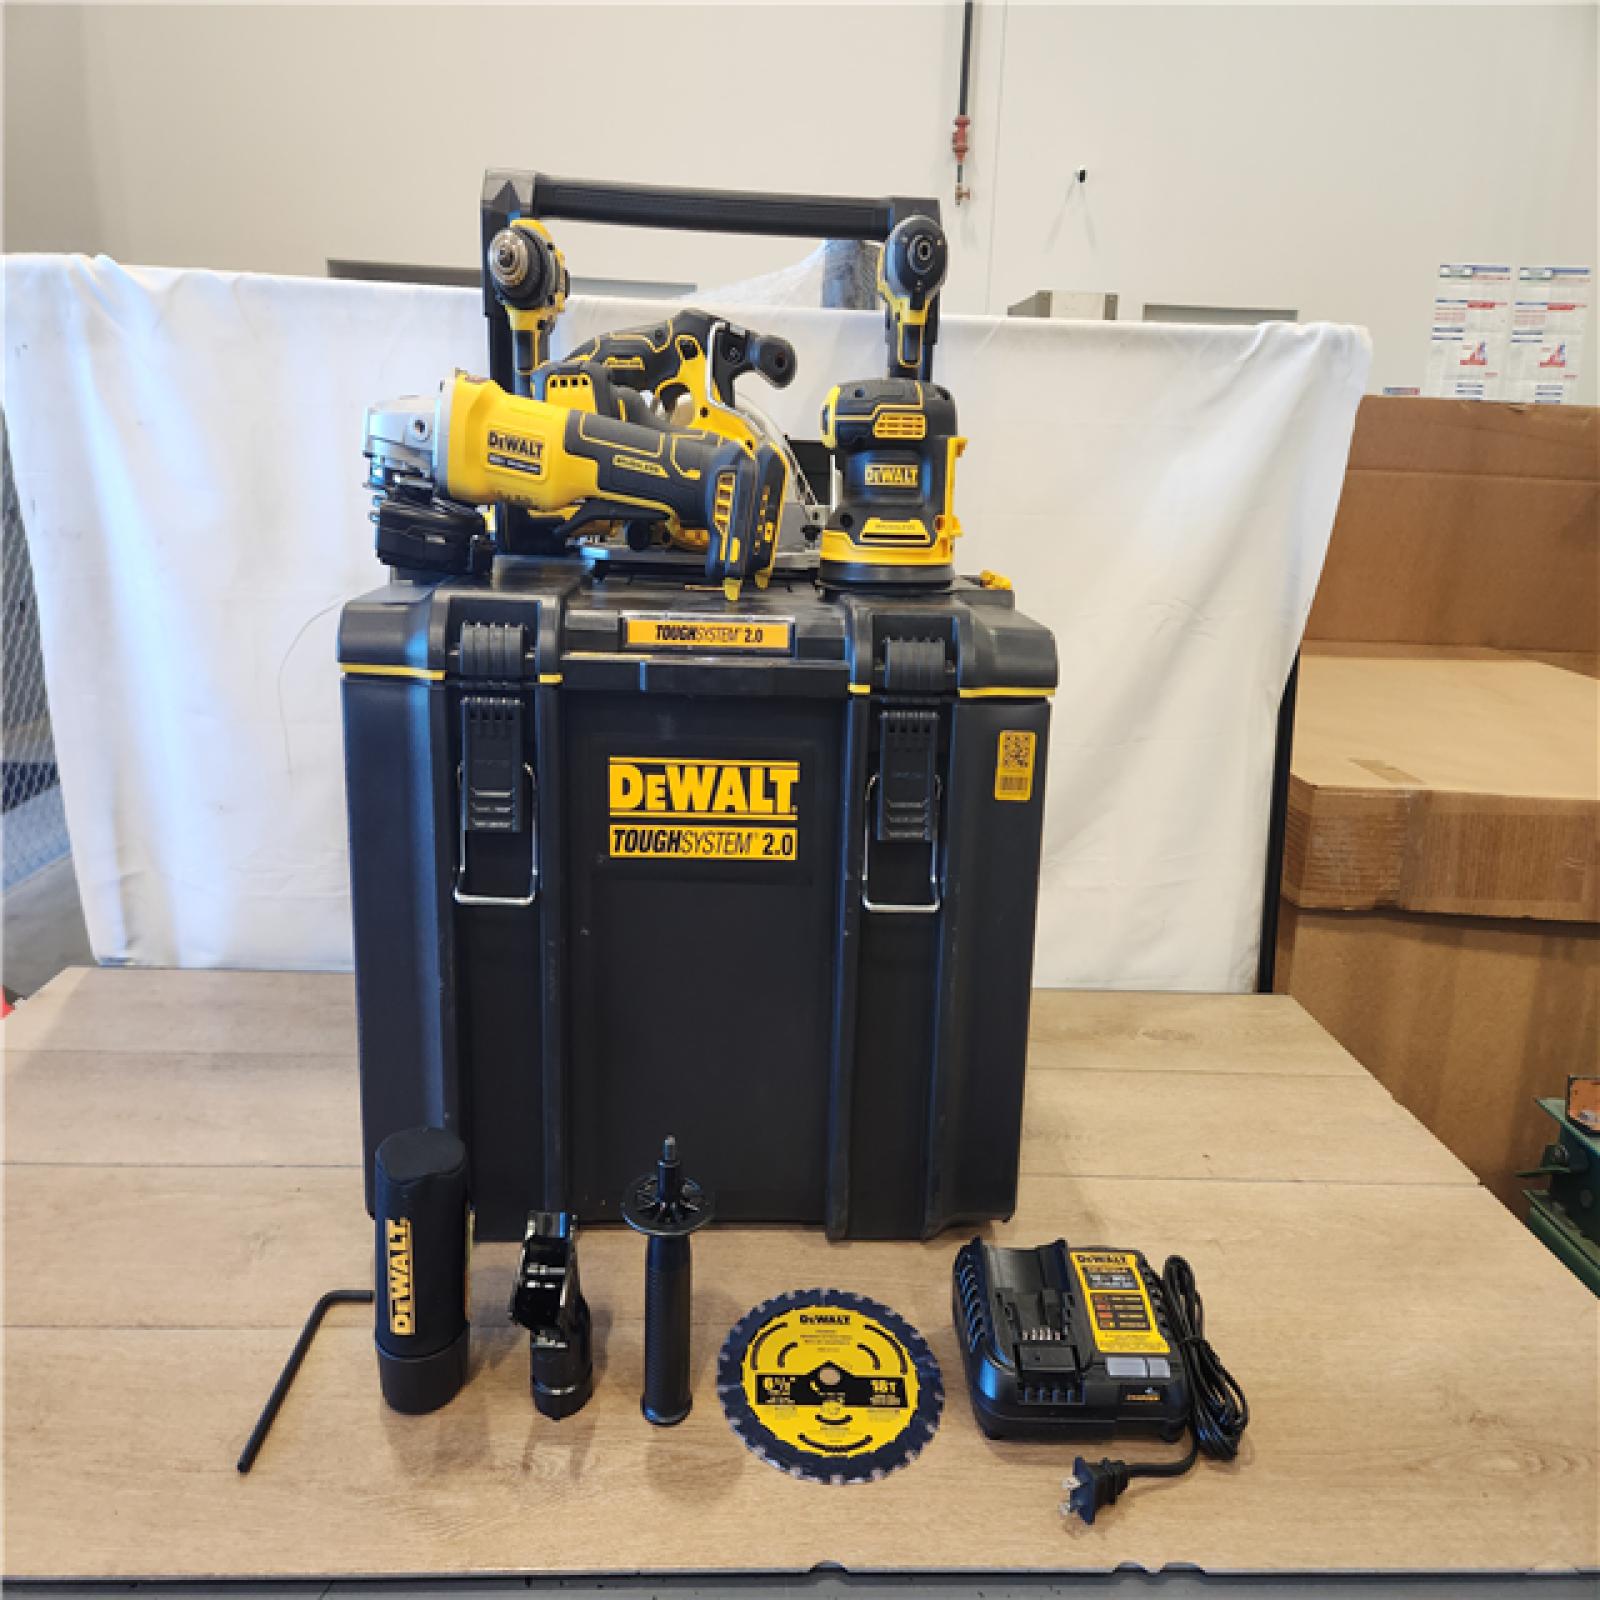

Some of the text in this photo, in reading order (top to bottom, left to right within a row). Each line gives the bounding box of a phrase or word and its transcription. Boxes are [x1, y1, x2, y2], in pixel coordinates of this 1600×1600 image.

[744, 628, 763, 643] 2.0
[609, 764, 799, 814] DEWALT
[762, 833, 793, 856] 2.0
